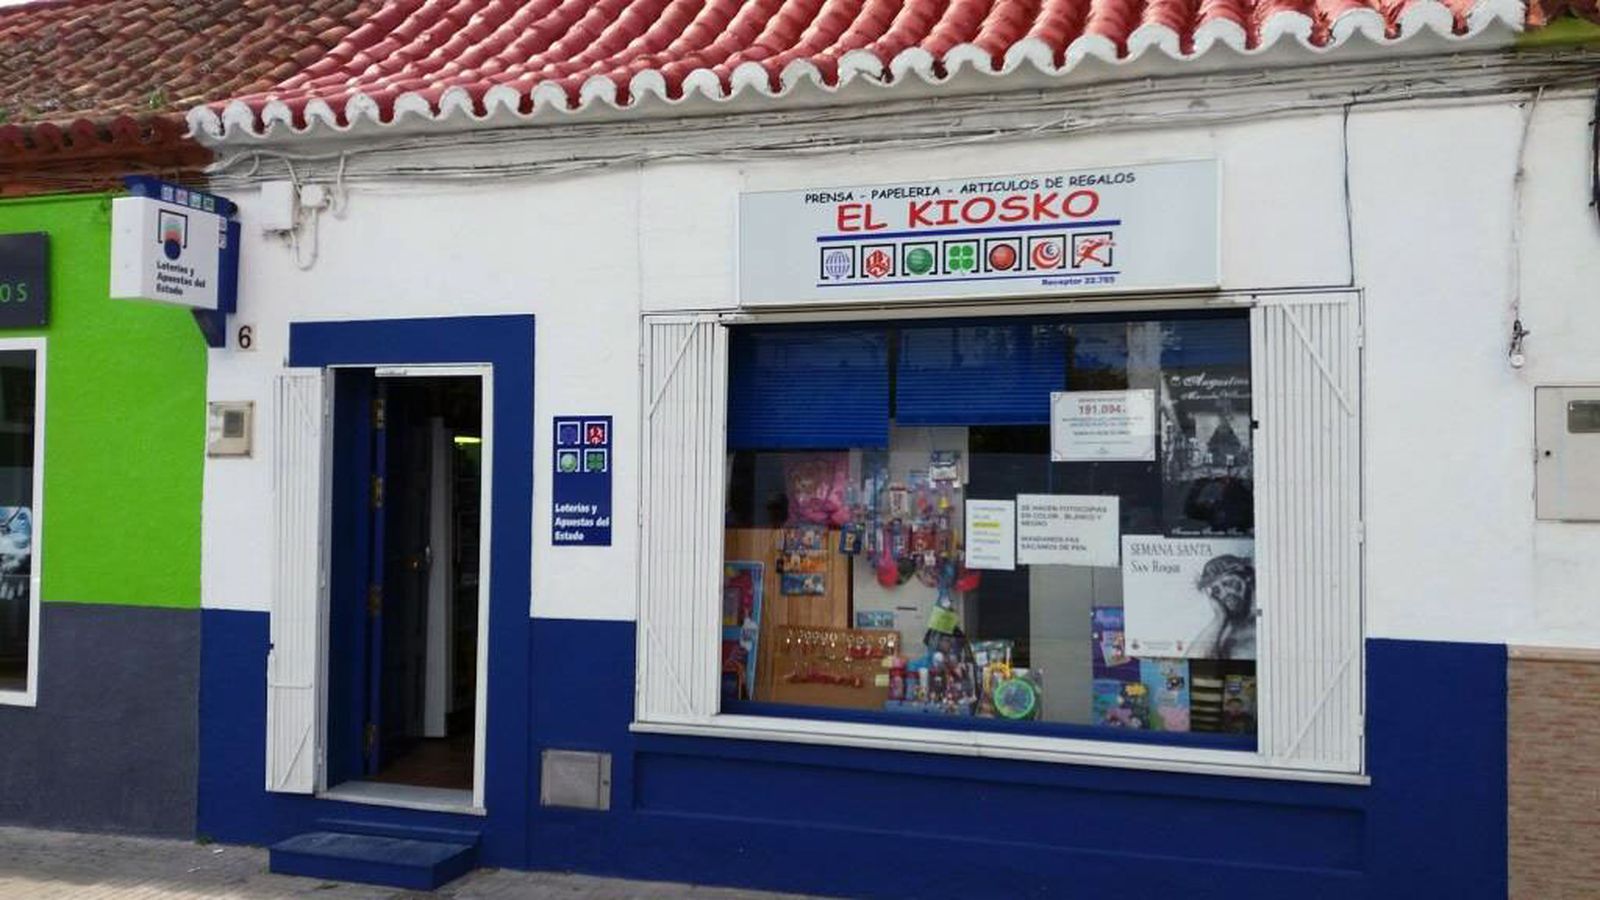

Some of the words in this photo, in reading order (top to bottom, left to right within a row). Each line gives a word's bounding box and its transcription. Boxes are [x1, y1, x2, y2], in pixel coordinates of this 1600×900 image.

[805, 192, 854, 204] PRENSA
[871, 187, 940, 200] PAPELERIA
[960, 179, 1039, 194] ARTICULOS
[1045, 176, 1063, 188] DE
[1069, 172, 1136, 187] REGALOS
[837, 203, 888, 232] EL
[908, 190, 1100, 228] KIOSKO
[157, 271, 192, 286] Apuestas
[194, 277, 206, 288] del
[190, 268, 194, 278] y
[156, 283, 183, 296] Estado
[238, 325, 251, 349] 6
[592, 504, 597, 515] y
[555, 517, 594, 528] Apuestas
[596, 517, 609, 527] del
[555, 531, 584, 541] Estado
[1130, 543, 1173, 556] SEMANA
[1177, 543, 1213, 557] SANTA
